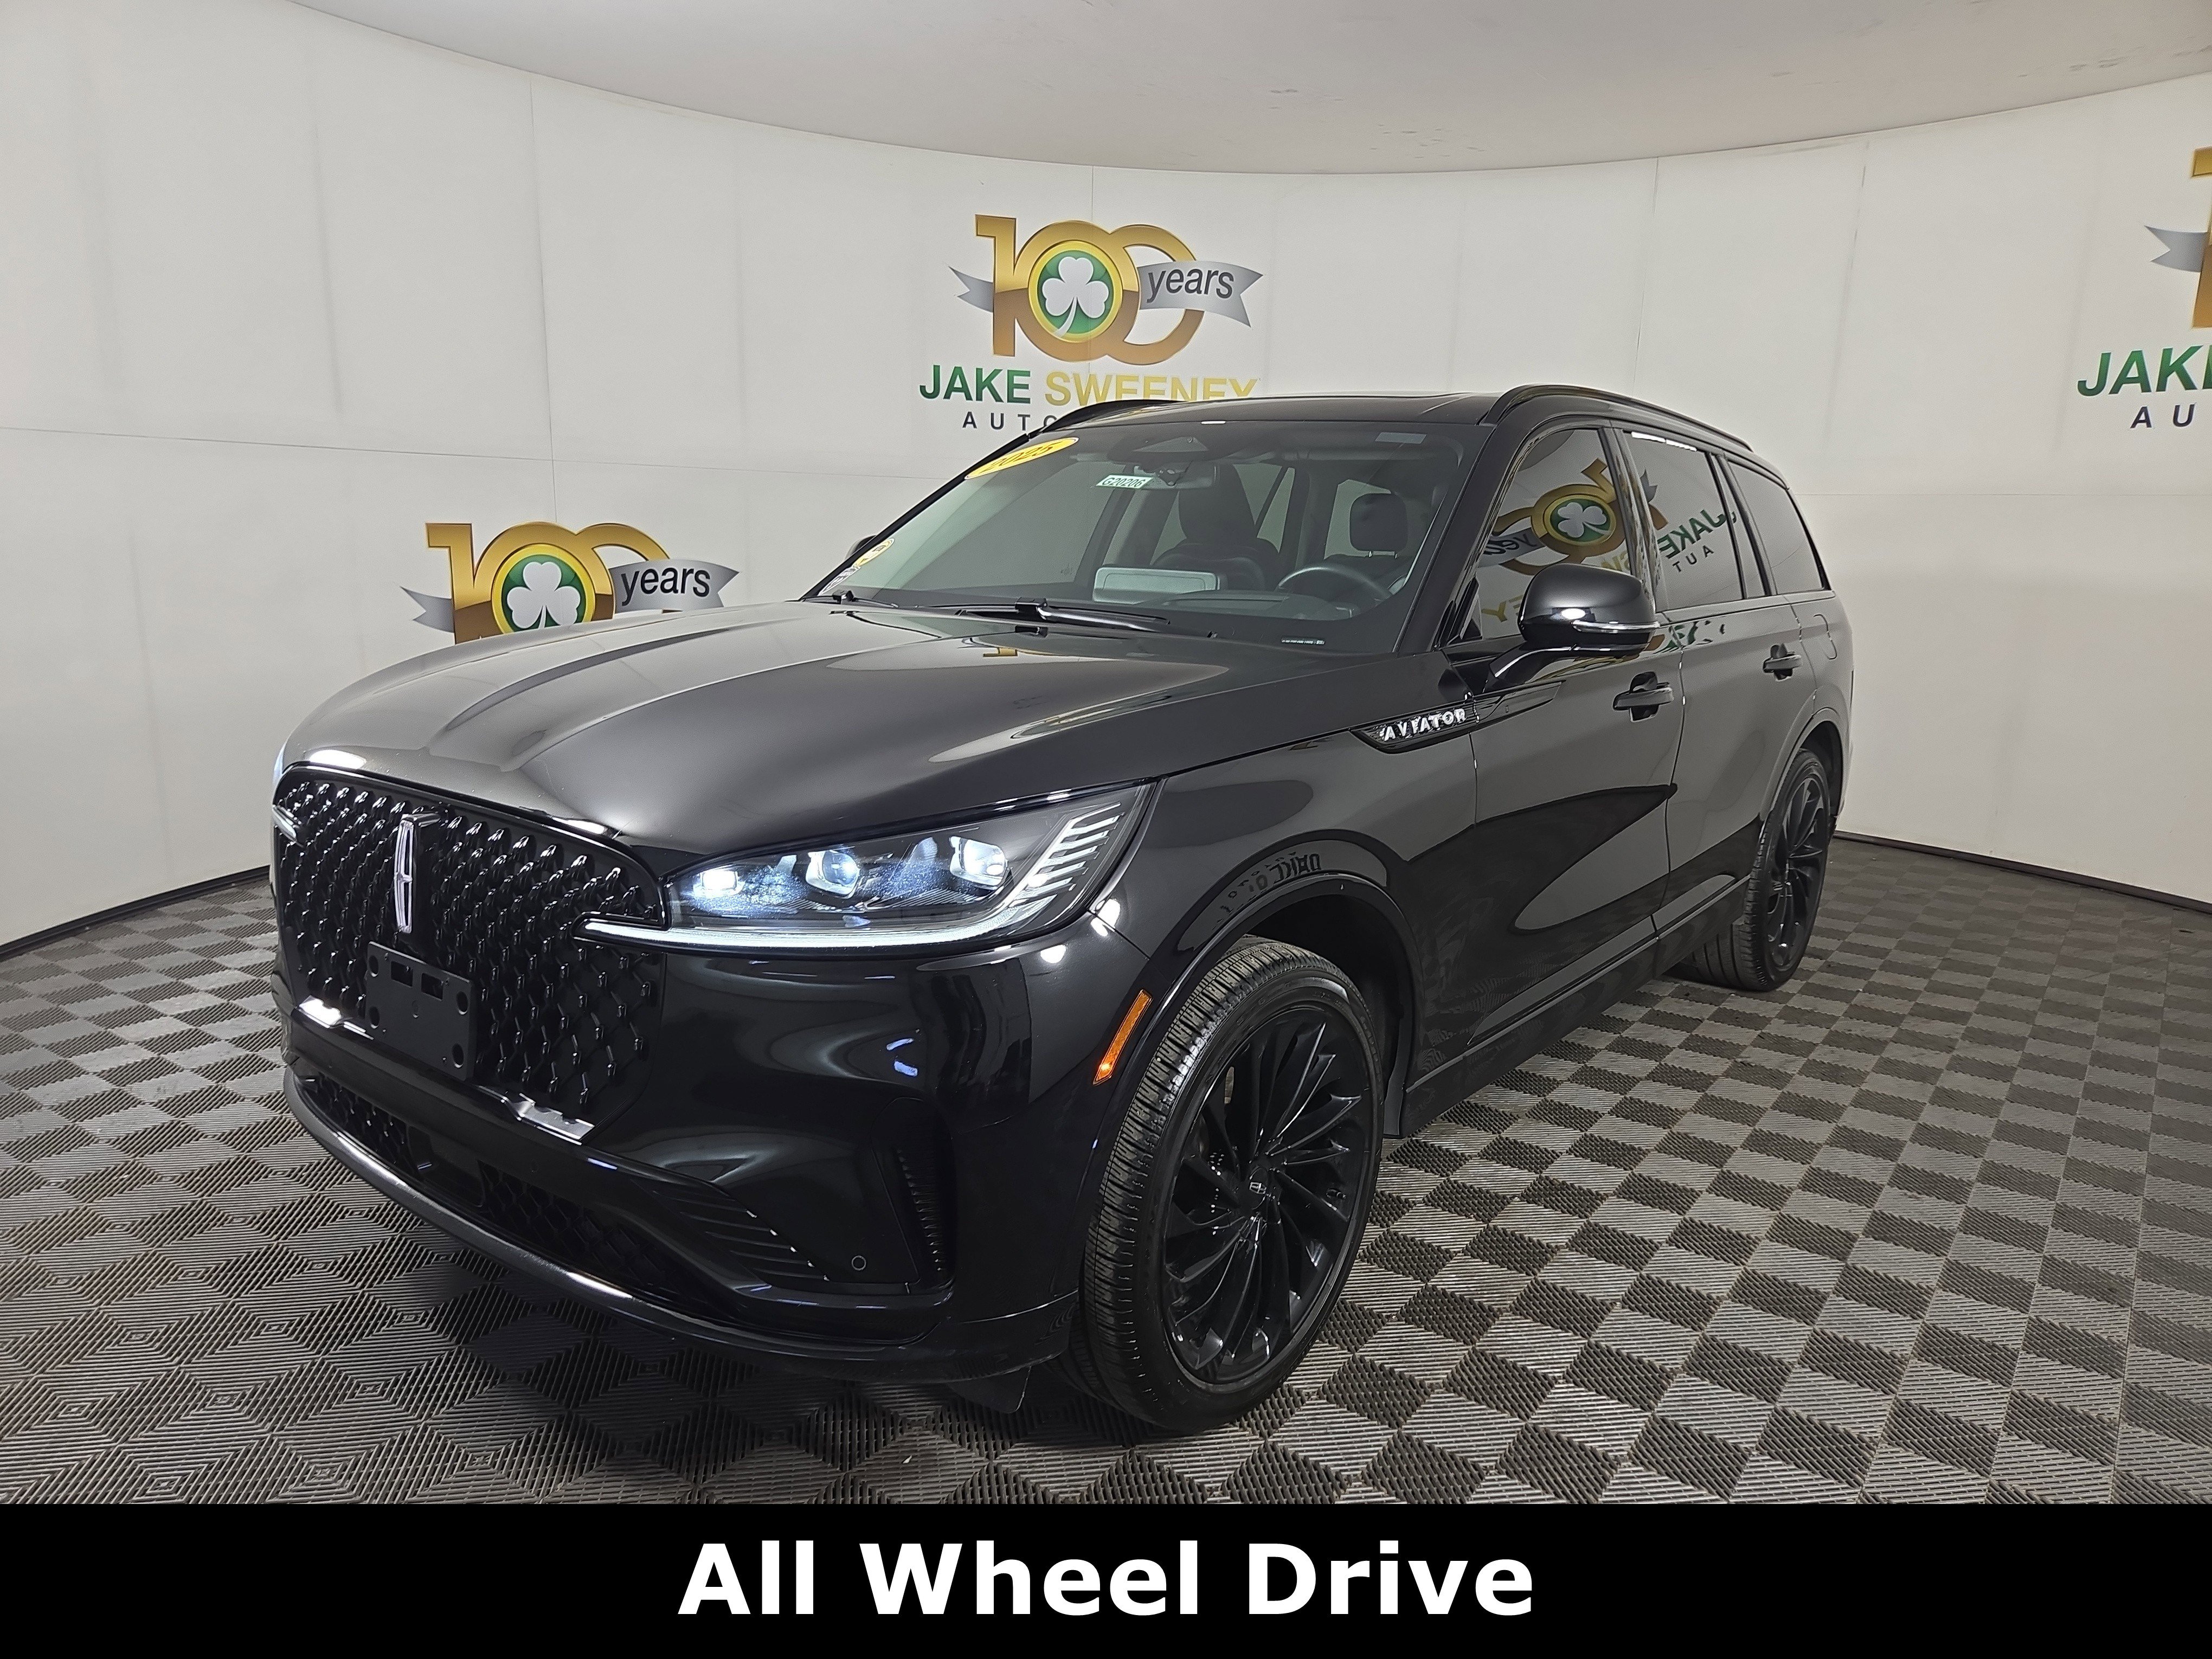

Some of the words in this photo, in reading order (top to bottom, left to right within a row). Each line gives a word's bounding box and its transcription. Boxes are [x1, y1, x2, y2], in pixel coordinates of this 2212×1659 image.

[1146, 266, 1234, 304] years
[919, 364, 1031, 403] JAKE
[1045, 371, 1257, 407] SWEENEY
[980, 441, 1062, 474] 2025
[1102, 477, 1146, 487] G20206
[621, 567, 710, 606] years
[1382, 708, 1467, 741] AVIATOR
